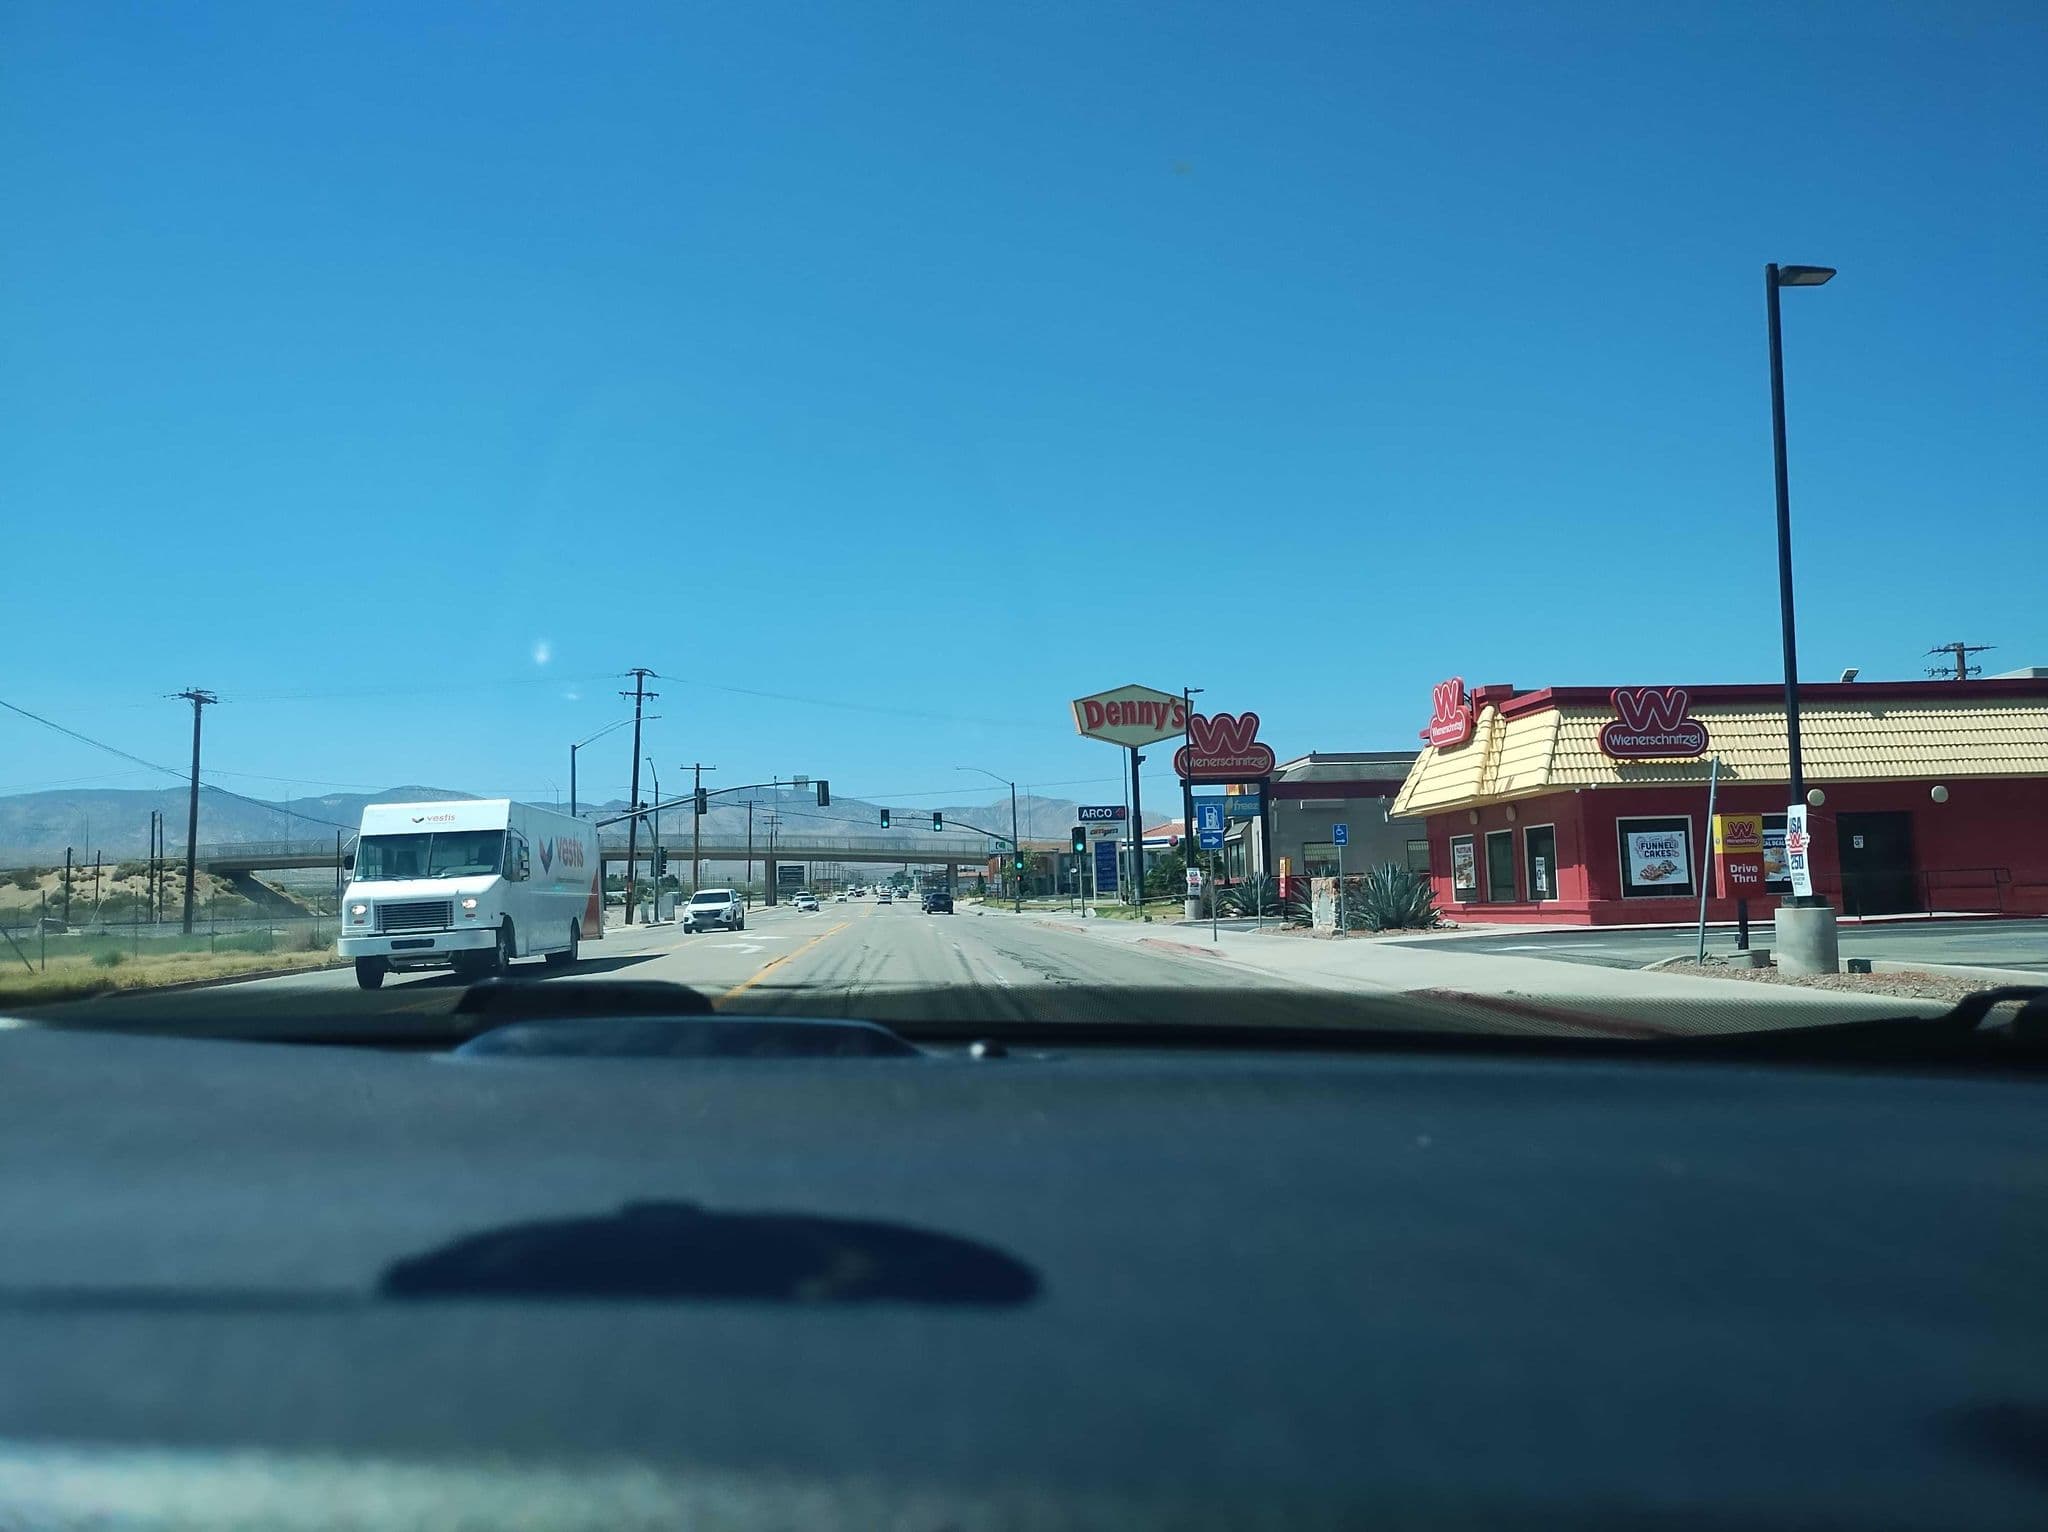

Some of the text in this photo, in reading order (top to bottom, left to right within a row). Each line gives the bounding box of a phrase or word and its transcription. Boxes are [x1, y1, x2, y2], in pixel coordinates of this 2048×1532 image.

[1083, 697, 1186, 732] Denny's
[1609, 732, 1701, 748] Wienerschnitzel
[1081, 808, 1113, 818] ARCO
[1641, 841, 1674, 850] FUNNEL
[556, 835, 584, 869] vestis
[1645, 849, 1672, 858] CAKES
[1730, 864, 1758, 873] Drive
[1732, 874, 1757, 883] Thru
